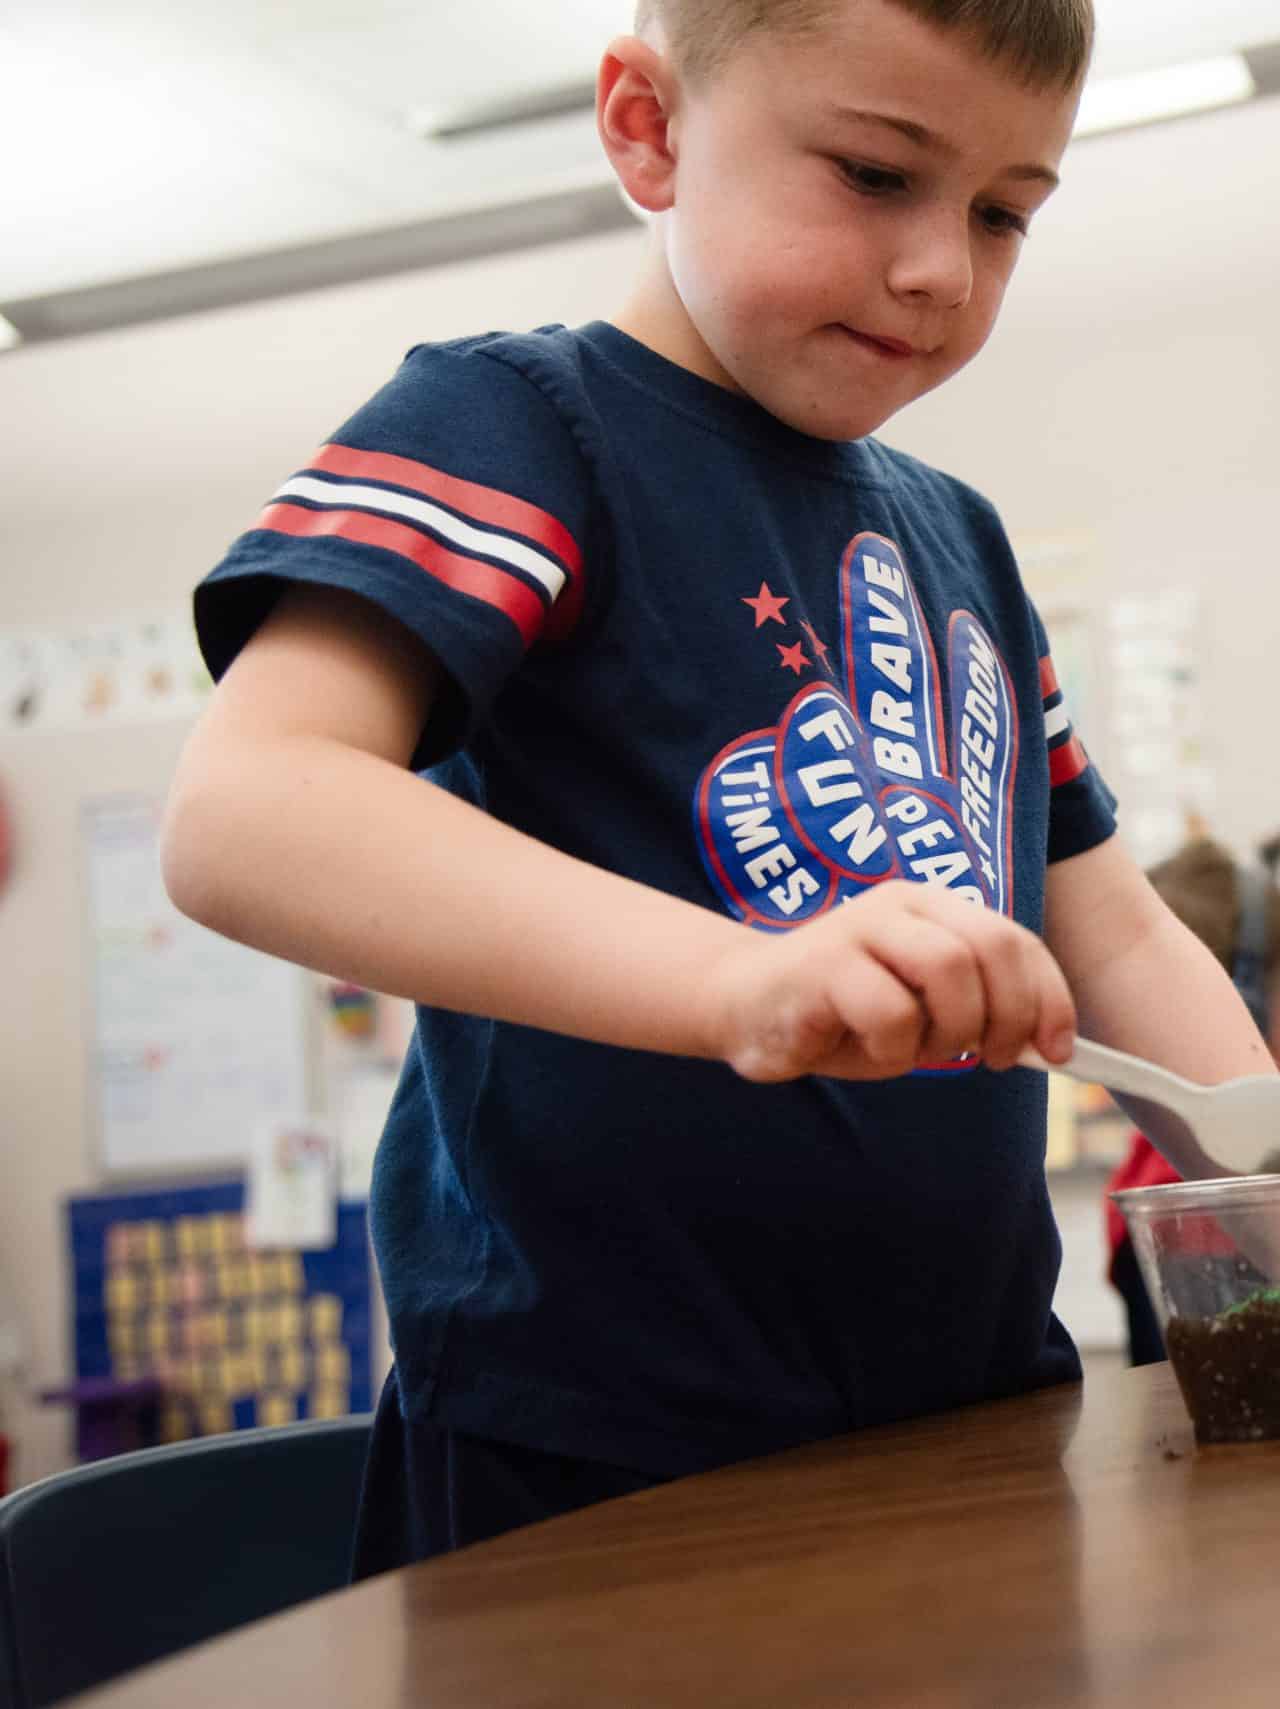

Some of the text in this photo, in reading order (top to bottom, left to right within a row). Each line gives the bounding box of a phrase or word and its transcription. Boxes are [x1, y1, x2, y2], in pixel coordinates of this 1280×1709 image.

[863, 554, 923, 780] BRAVE
[960, 623, 999, 857] FREEDOM
[798, 708, 888, 866] FUN
